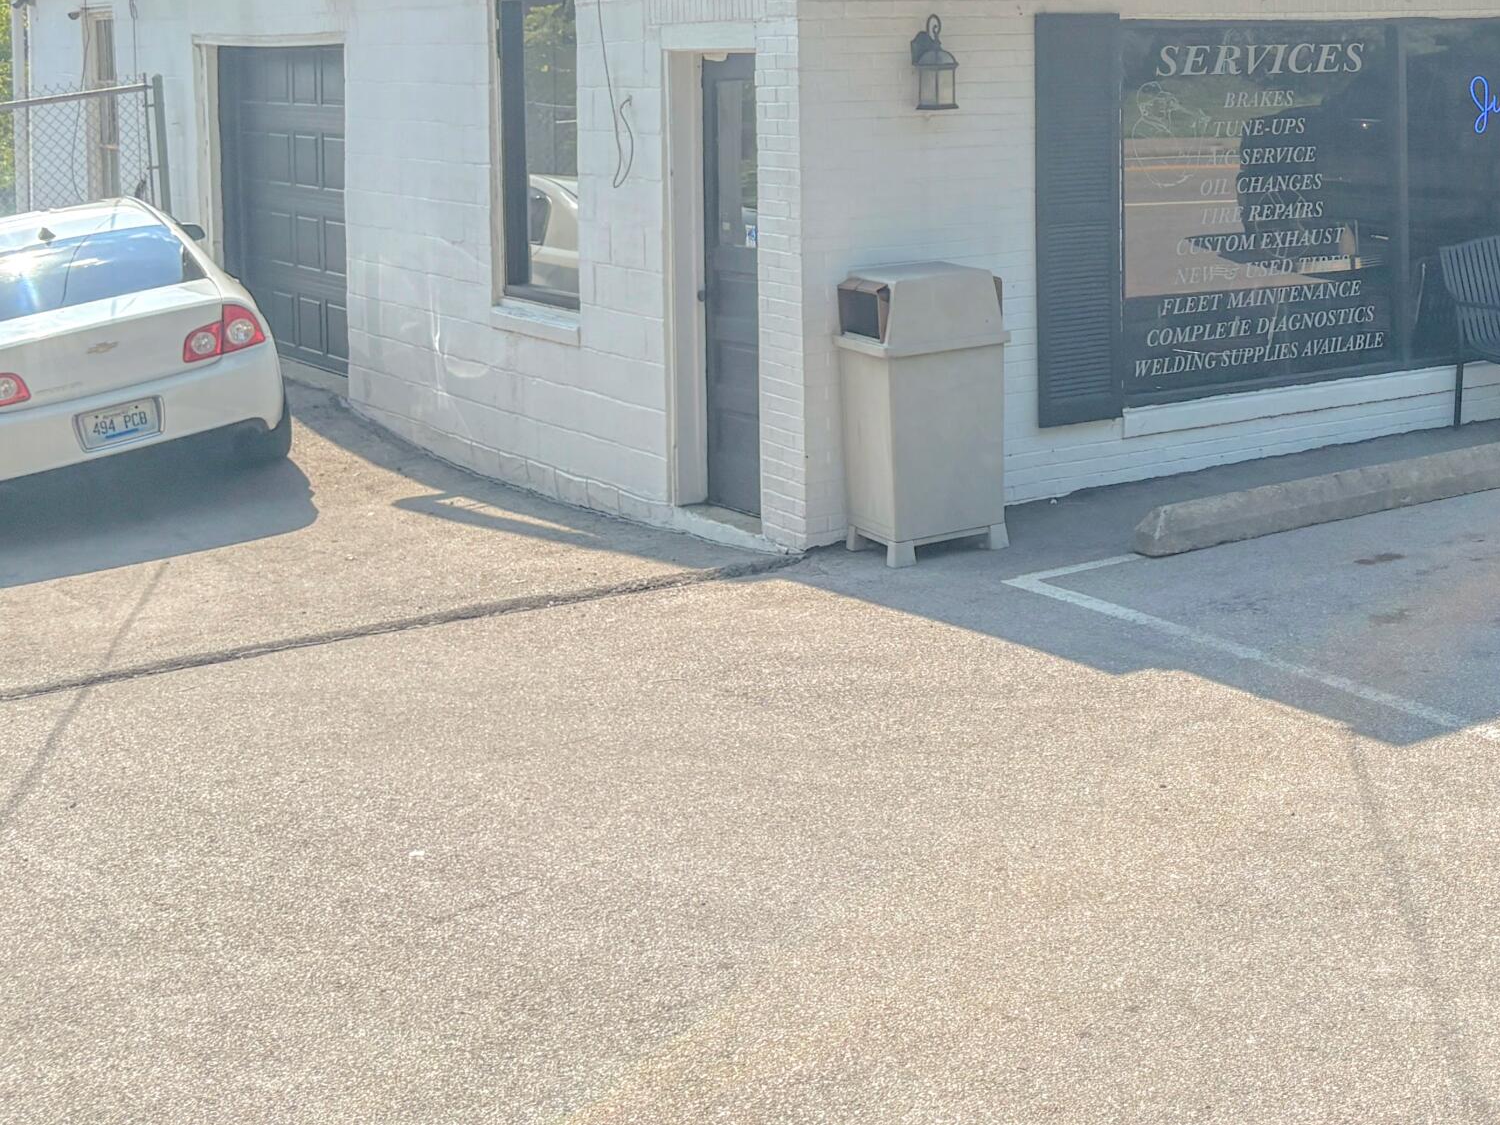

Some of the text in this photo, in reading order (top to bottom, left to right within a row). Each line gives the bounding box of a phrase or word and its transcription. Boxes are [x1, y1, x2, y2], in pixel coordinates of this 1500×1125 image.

[1156, 42, 1365, 77] SERVICES
[1223, 90, 1294, 108] BRAKES
[1213, 117, 1305, 138] TUNE-UPS
[1241, 146, 1316, 165] SERVICE
[1200, 174, 1322, 197] OIL CHANGES
[1201, 201, 1324, 225] TIRE REPAIRS
[1176, 227, 1346, 256] CUSTOM EXHAUST
[1174, 266, 1215, 286] NEW
[1245, 259, 1293, 278] USED
[1161, 280, 1362, 316] FLEET MAINTENANCE
[1147, 306, 1375, 347] COMPLETE DIAGNOSTICS
[1135, 331, 1384, 377] WELDING SUPPLIES AVAILABLE
[93, 419, 116, 435] 494
